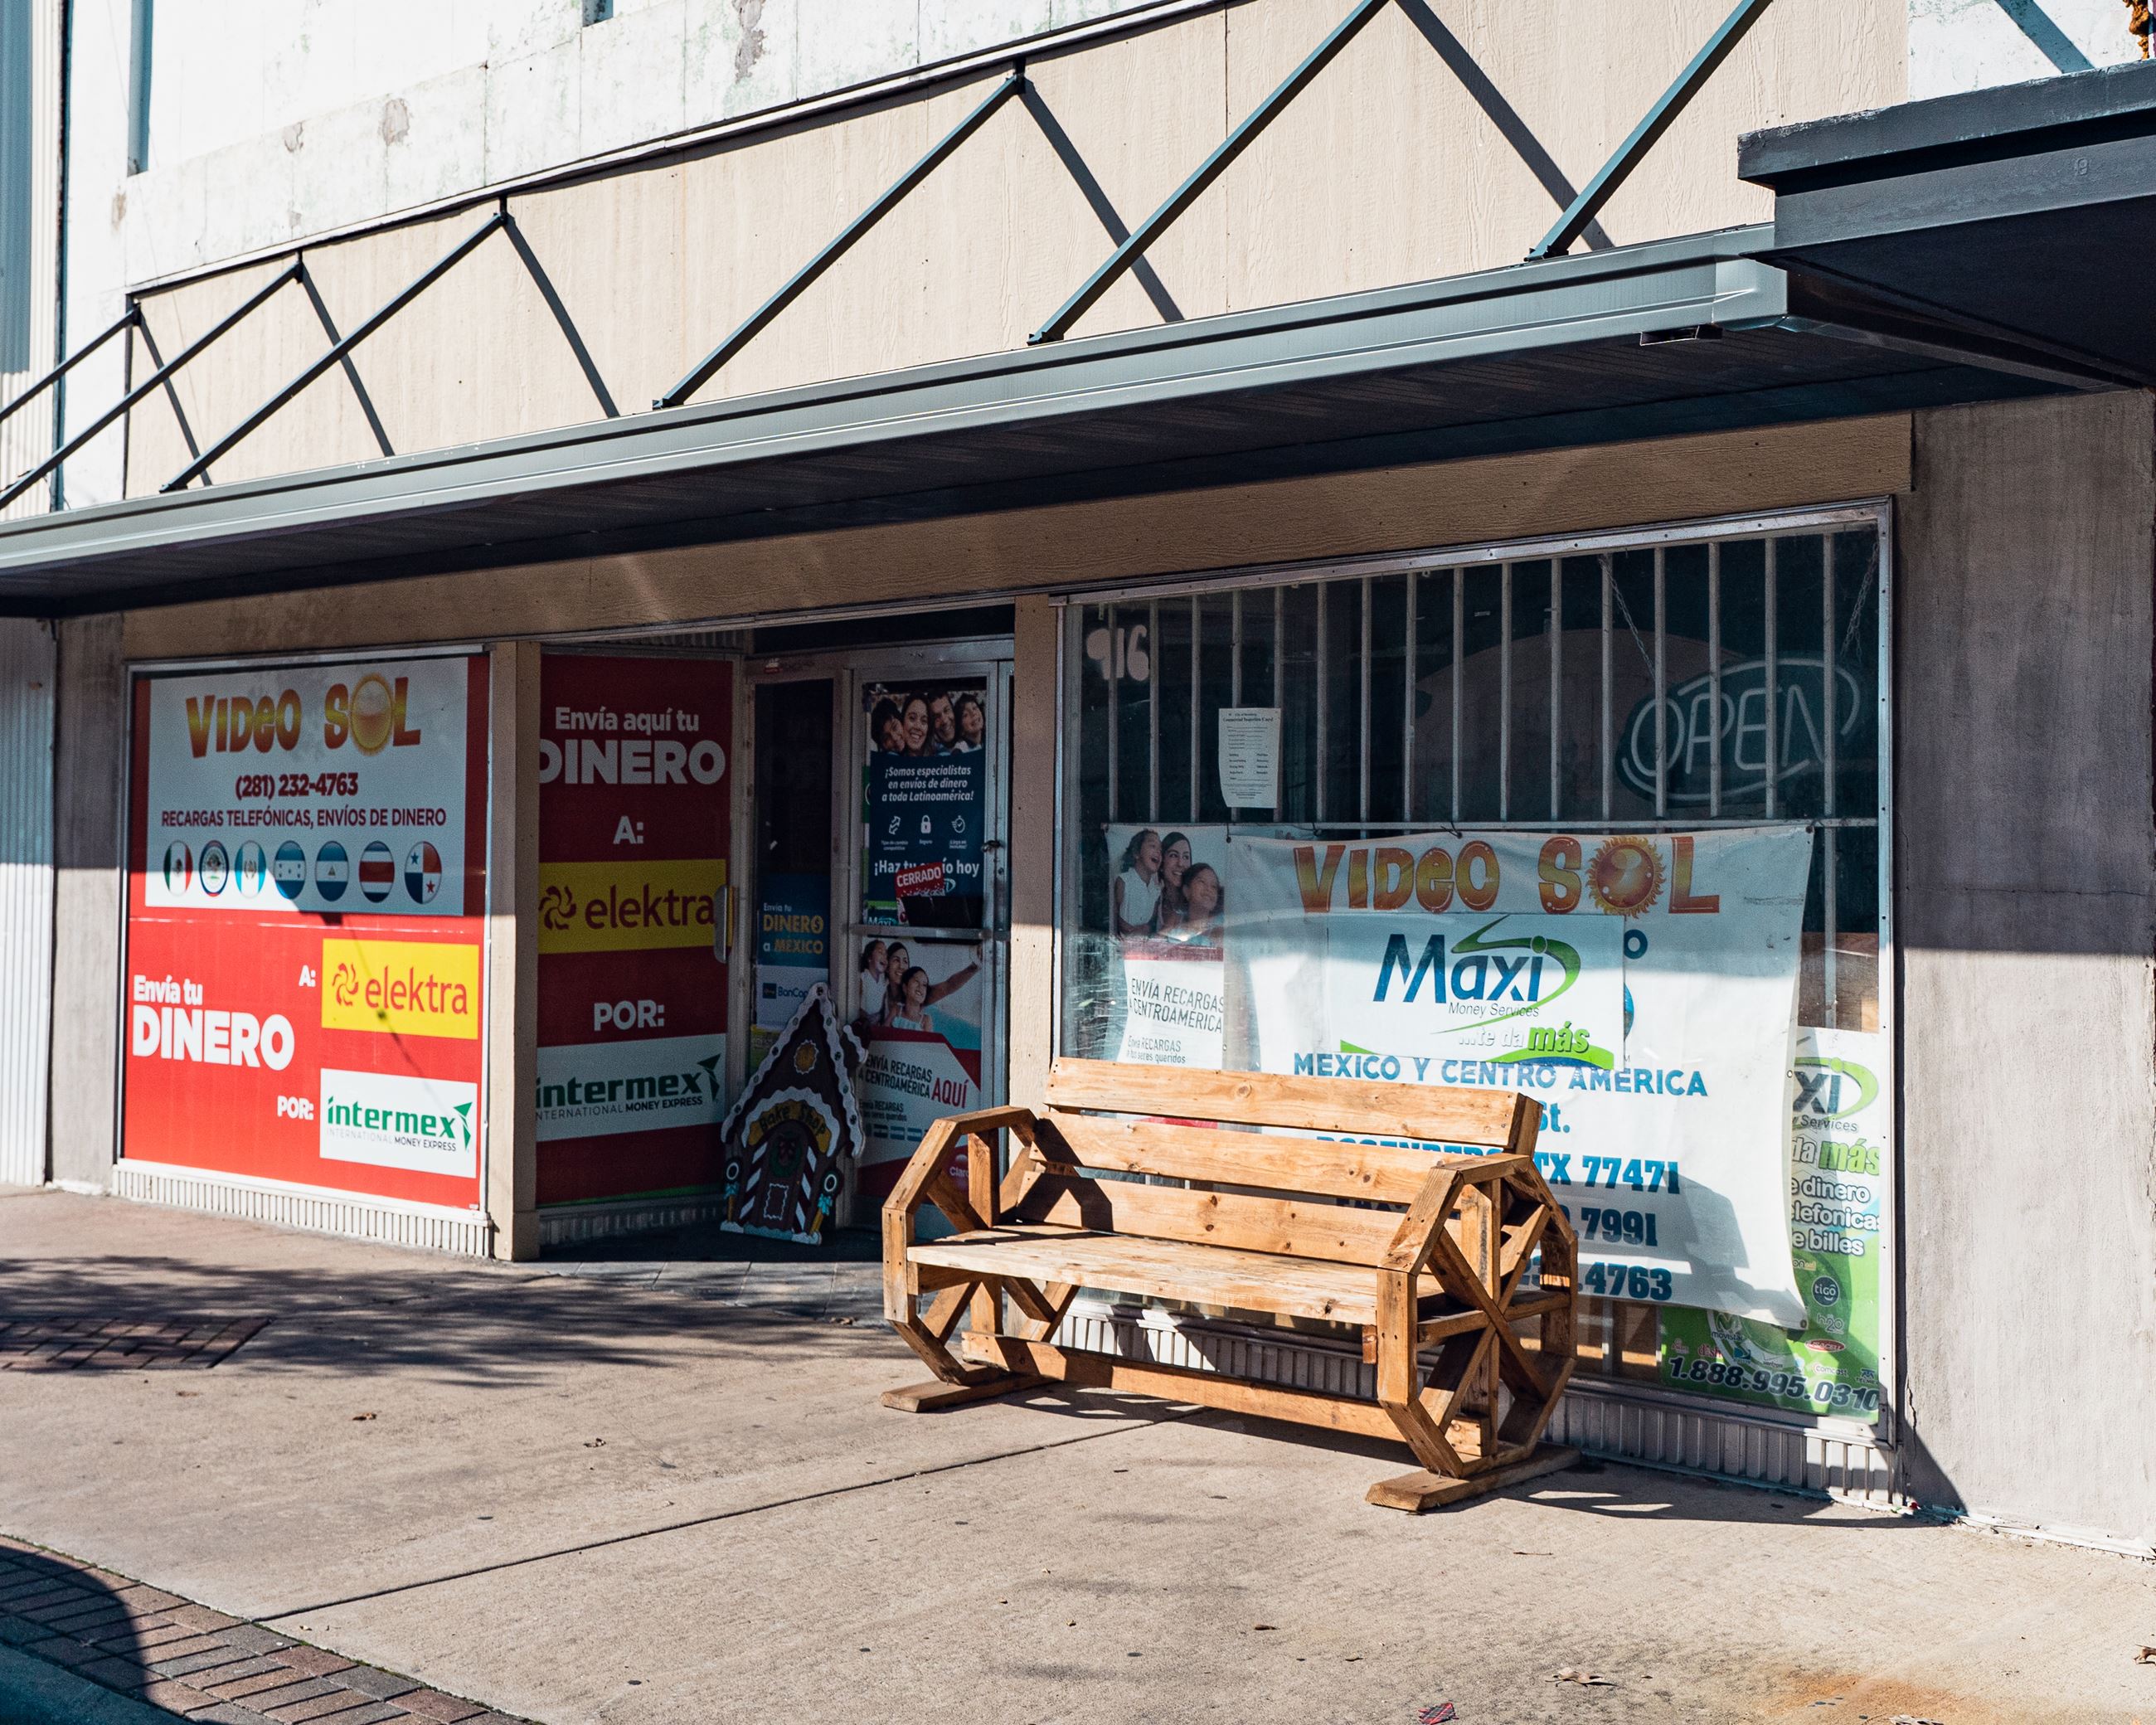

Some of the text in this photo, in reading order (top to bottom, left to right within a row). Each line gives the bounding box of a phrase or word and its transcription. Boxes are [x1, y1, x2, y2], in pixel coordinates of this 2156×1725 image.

[1086, 624, 1149, 681] 916
[324, 674, 421, 756] SOL
[555, 706, 699, 736] Envía aquí tu
[1631, 684, 1829, 777] OPEN
[539, 738, 726, 785] DINERO
[885, 765, 972, 779] ¡Somos especialistas
[236, 772, 359, 800] (281) 232-4763
[888, 777, 968, 790] en envíos de dinero
[889, 792, 908, 802] toda
[909, 789, 974, 802] Latinoamérica!
[162, 804, 446, 829] RECARGAS TELEFÓNICAS, ENVÍOS DE DINERO
[613, 815, 643, 844] A:
[875, 859, 901, 876] ¡Haz
[956, 859, 979, 877] hoy
[896, 867, 942, 887] CERRADO
[585, 883, 715, 930] elektra
[763, 942, 770, 952] a
[299, 965, 316, 988] A:
[1373, 934, 1547, 1003] Maxi
[134, 974, 203, 1005] Envía tu
[365, 966, 468, 1015] elektra
[1131, 978, 1224, 1013] ENVÍA RECARGAS
[594, 999, 665, 1032] POR:
[1449, 1002, 1540, 1018] Money Services
[133, 1004, 295, 1071] DINERO
[1141, 1037, 1182, 1052] RECARGAS
[1502, 1028, 1524, 1047] da
[1527, 1021, 1590, 1053] más
[891, 1060, 932, 1083] RECARGAS
[1155, 1053, 1186, 1064] queridos
[1294, 1052, 1707, 1096] MEXICO Y CENTRO AMERICA
[1792, 1057, 1843, 1115] xi
[536, 1072, 702, 1108] intermex
[931, 1077, 969, 1108] AQUÍ
[277, 1096, 314, 1120] POR:
[328, 1096, 456, 1139] intermex
[536, 1096, 702, 1121] NTERNATIONAL MONEY EXPRESS
[1800, 1115, 1858, 1132] Services
[327, 1127, 456, 1152] INTERNATIONAL MONEY EXPRESS
[1819, 1139, 1879, 1175] más
[1533, 1151, 1680, 1194] TX 77471
[1801, 1175, 1871, 1203] dinero
[1792, 1200, 1879, 1232] lefonica
[1808, 1228, 1865, 1256] billes
[1669, 1355, 1879, 1412] 1.888.995.0310
